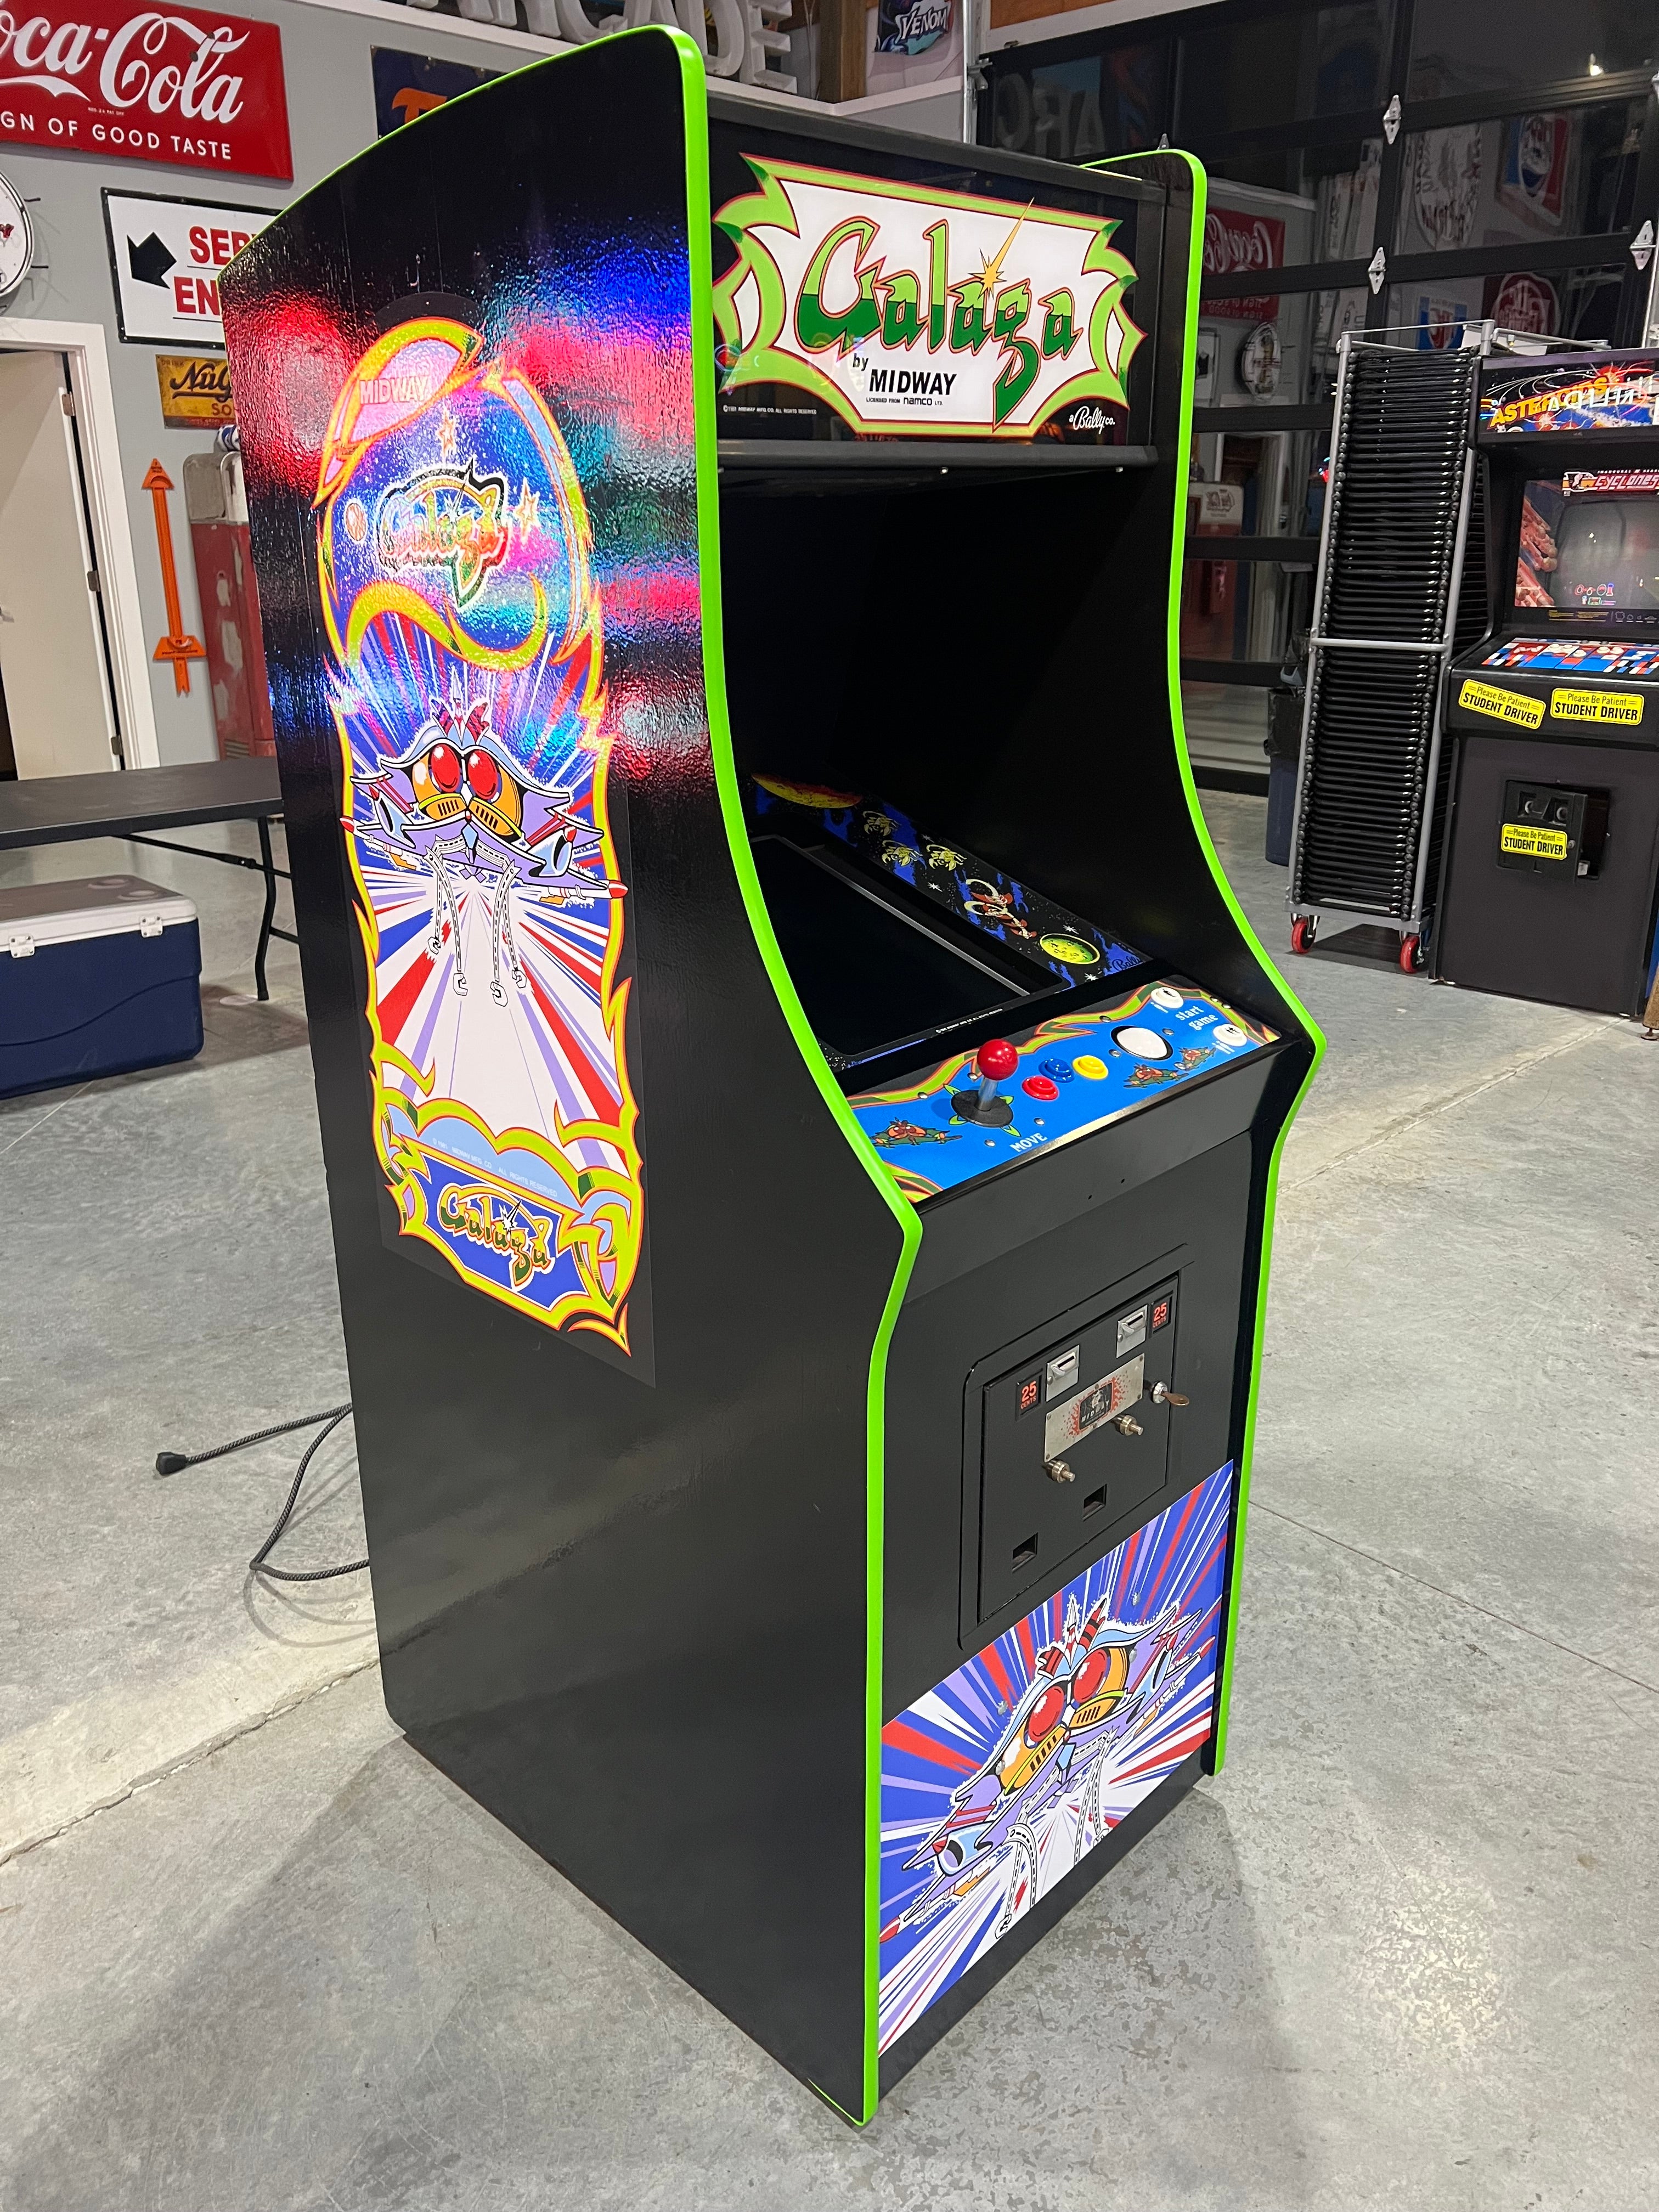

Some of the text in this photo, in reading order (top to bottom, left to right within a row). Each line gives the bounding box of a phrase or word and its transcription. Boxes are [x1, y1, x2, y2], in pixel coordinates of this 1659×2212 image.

[900, 7, 947, 40] VENOM
[48, 117, 78, 137] OF
[92, 123, 160, 149] GOOD
[170, 135, 232, 160] TASTE
[189, 225, 259, 266] SER
[794, 215, 1084, 432] Galaga
[852, 353, 869, 371] by
[359, 377, 428, 405] MIDWAY
[868, 369, 957, 396] MIDWAY
[903, 397, 933, 406] namco
[1073, 405, 1105, 435] Bally
[1105, 417, 1115, 425] co.
[1595, 475, 1659, 490] CYCLONES
[1476, 686, 1531, 710] Please Be Patient
[1567, 693, 1627, 707] Please Be Patient
[1463, 692, 1539, 726] STUDENT DRIVER
[1554, 702, 1638, 721] STUDENT DRIVER
[1513, 828, 1556, 842] Please Be Patient
[1504, 836, 1564, 856] STUDENT DRIVER
[1175, 1005, 1204, 1021] start
[1188, 1014, 1218, 1031] game
[1009, 1132, 1048, 1153] MOVE
[452, 1146, 471, 1160] MIDWAY
[498, 1166, 507, 1176] ALL
[509, 1172, 529, 1186] RIGHTS
[529, 1180, 557, 1197] RESERVED
[438, 1186, 550, 1285] Galaga
[1154, 1302, 1167, 1322] 25
[1022, 1380, 1037, 1402] 25
[1020, 1395, 1036, 1409] CENTS
